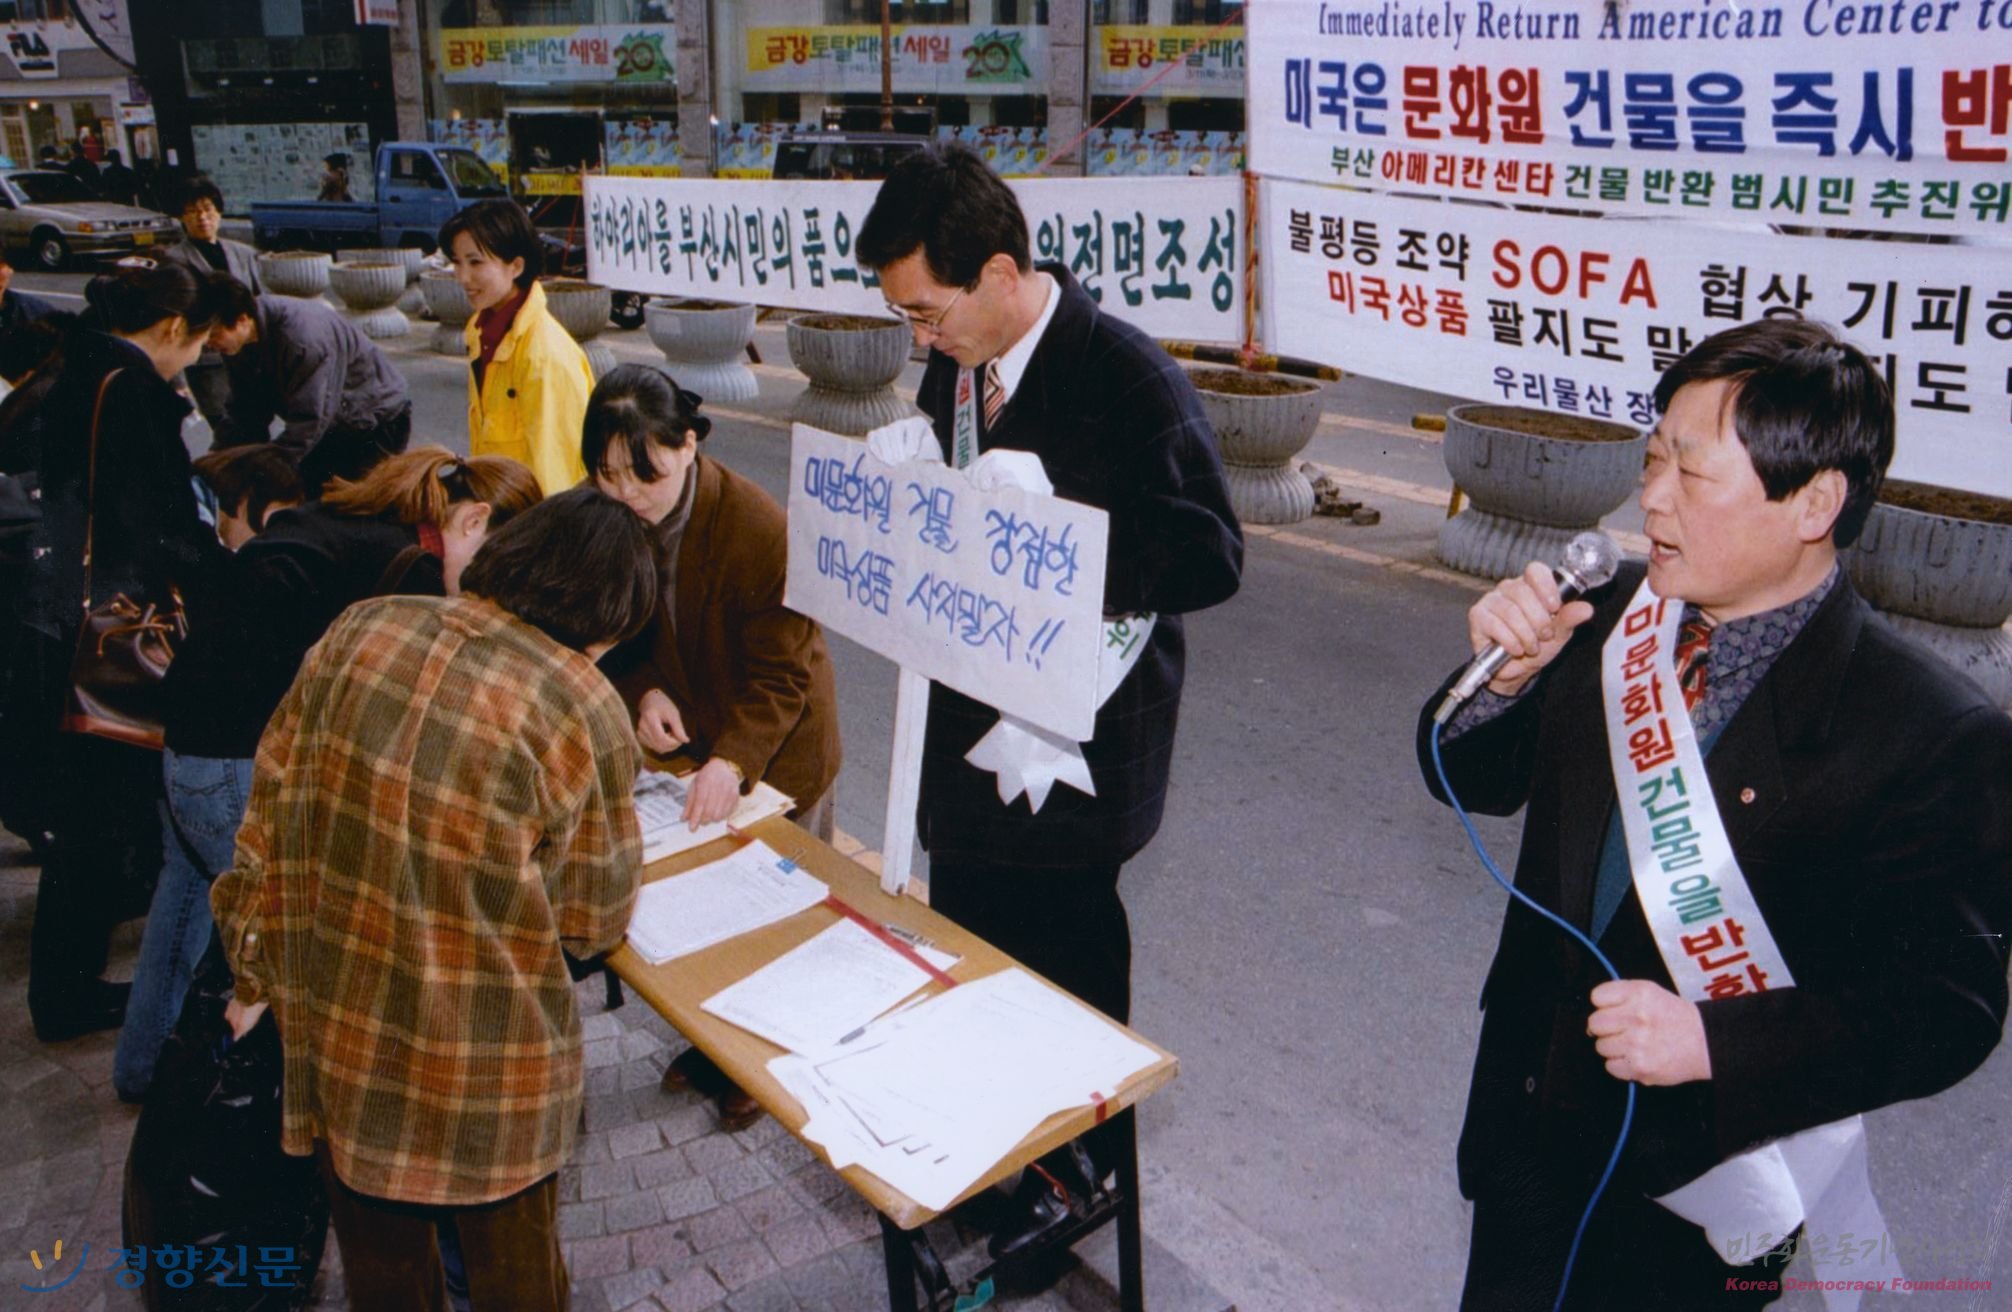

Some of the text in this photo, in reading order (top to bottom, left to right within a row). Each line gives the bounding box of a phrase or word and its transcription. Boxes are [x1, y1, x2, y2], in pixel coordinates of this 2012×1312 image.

[1319, 1, 1467, 50] Immediately
[1476, 1, 1580, 40] Return
[1598, 0, 1783, 40] American
[1803, 0, 1959, 37] Center
[1285, 58, 2012, 163] 미국은 문화원 건물을 즉시 반
[1330, 146, 1375, 178] 부산
[1565, 165, 1629, 201] 건물
[1643, 169, 1715, 207] 반환
[1731, 173, 1855, 216] 범시민
[1288, 209, 1380, 267] 불평등
[1396, 228, 1469, 281] 조약
[1492, 239, 1658, 310] SOFA
[1700, 264, 1813, 320] 협상
[1327, 270, 1470, 337] 미국상품
[1486, 298, 1625, 363] 팔지도
[1494, 365, 1613, 418] 우리물산
[804, 453, 893, 534] 미문화원
[985, 509, 1079, 596] 강점한
[817, 536, 895, 616] 미국상품
